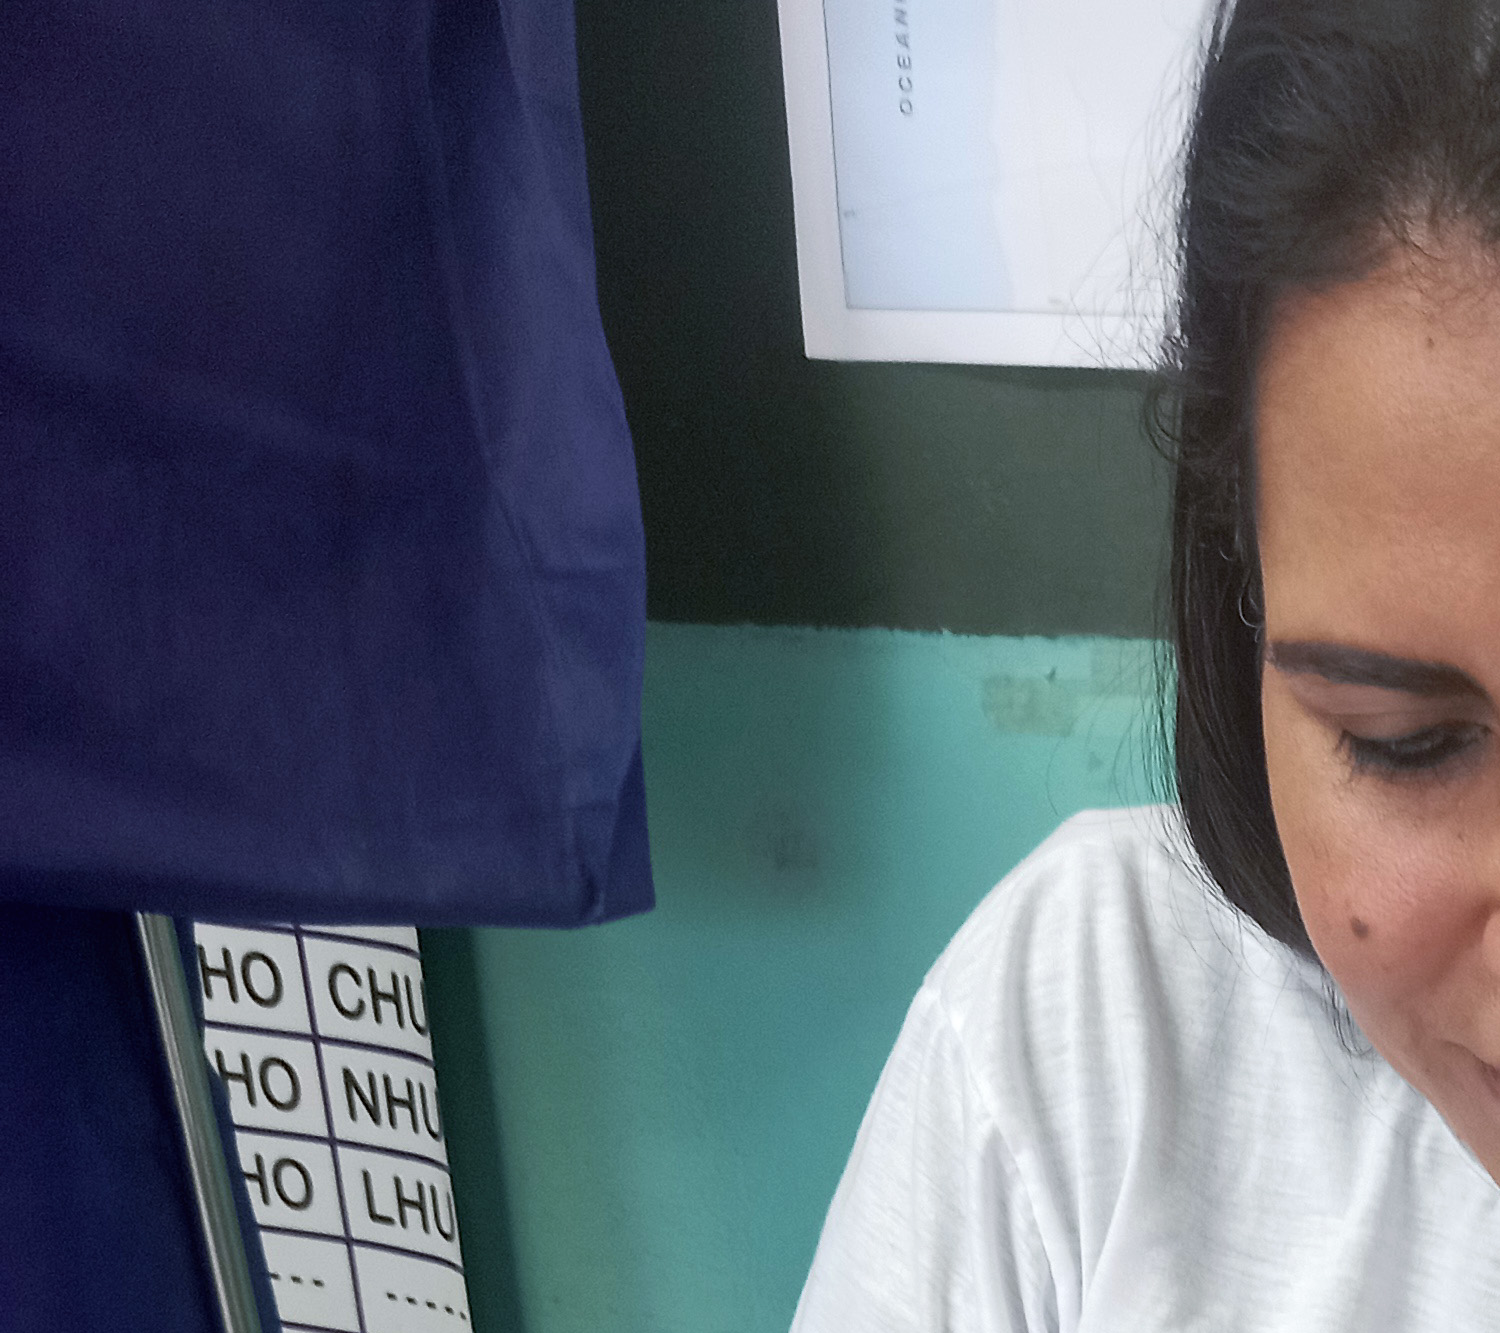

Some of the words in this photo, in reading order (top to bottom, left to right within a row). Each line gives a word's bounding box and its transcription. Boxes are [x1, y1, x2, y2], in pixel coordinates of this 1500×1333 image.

[893, 0, 913, 115] OCEAN
[327, 961, 429, 1036] CHU
[342, 1066, 444, 1142] NHU
[361, 1168, 456, 1243] LHU
